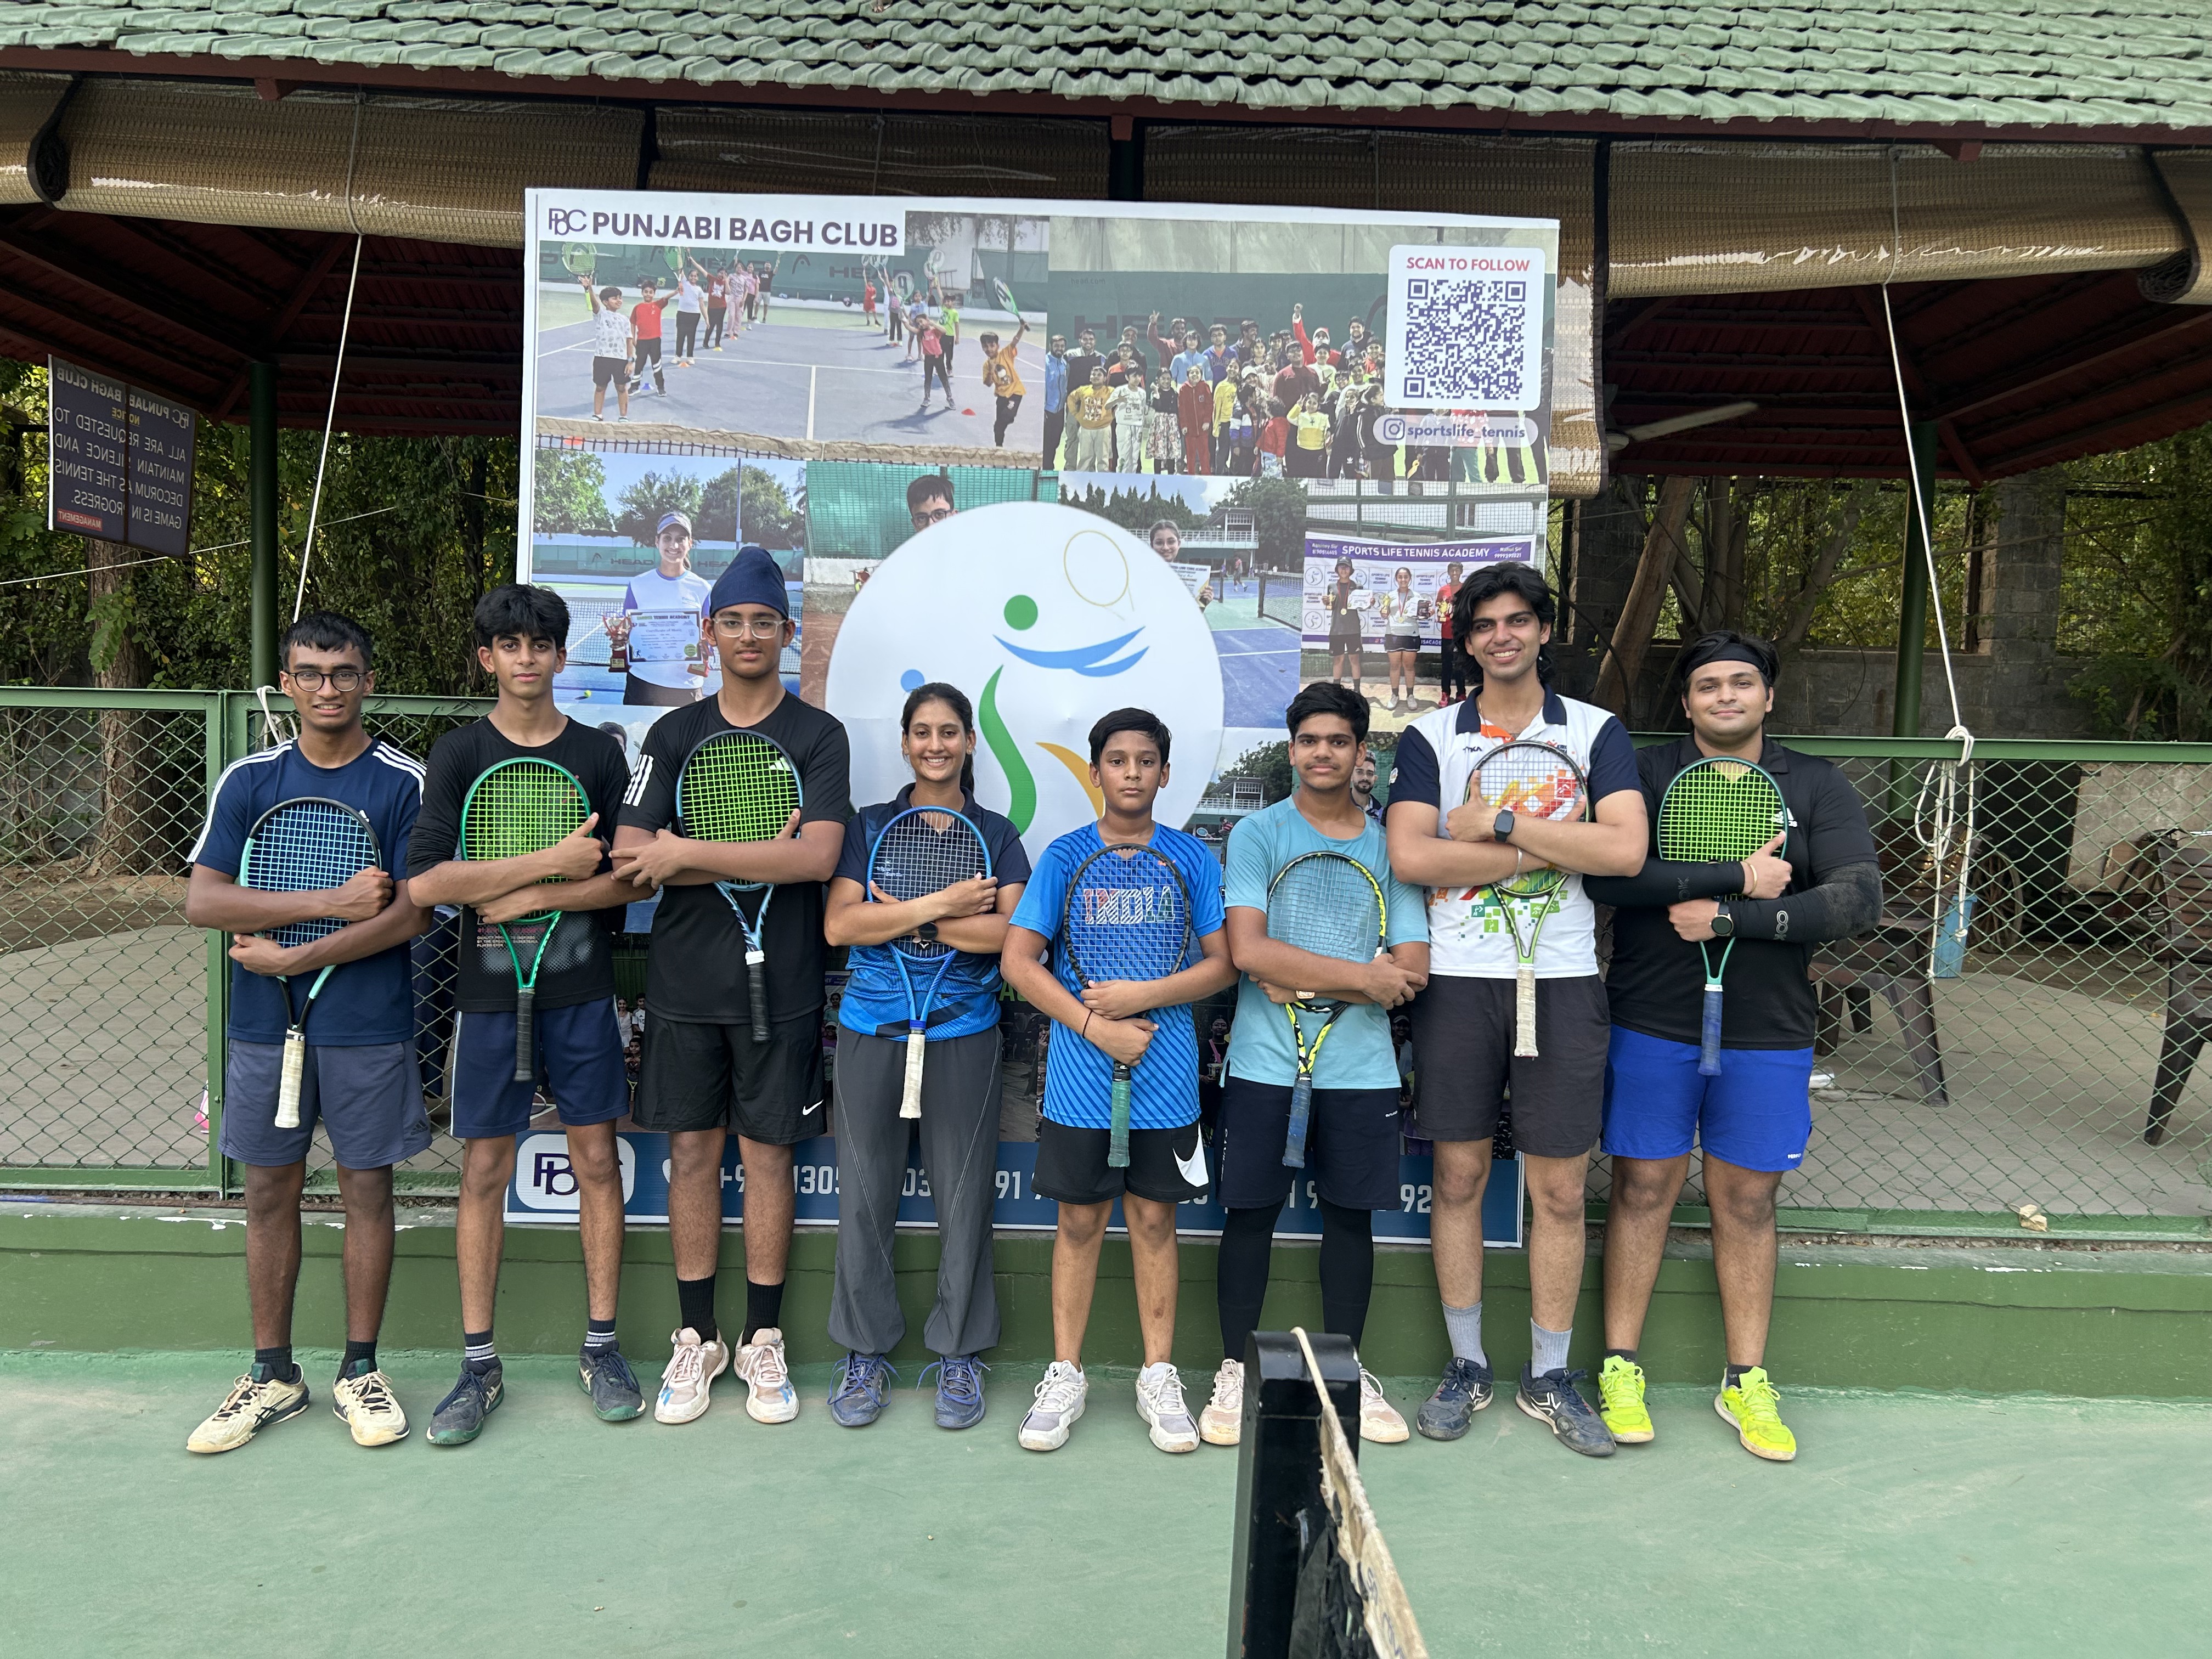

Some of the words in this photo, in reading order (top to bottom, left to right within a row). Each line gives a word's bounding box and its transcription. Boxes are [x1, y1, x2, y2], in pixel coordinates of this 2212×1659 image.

[592, 211, 721, 240] PUNJABI
[729, 218, 813, 244] BAGH
[822, 222, 898, 247] CLUB
[1406, 257, 1445, 270] SCAN
[1448, 258, 1468, 270] TO
[1471, 258, 1530, 272] FOLLOW
[1407, 424, 1525, 438] sportslife_tennis
[1342, 545, 1379, 556] SPORTS
[1381, 548, 1402, 557] LIFE
[1404, 548, 1440, 557] TENNIS
[1441, 548, 1490, 557] ACADEMY
[1083, 885, 1176, 925] INDIA
